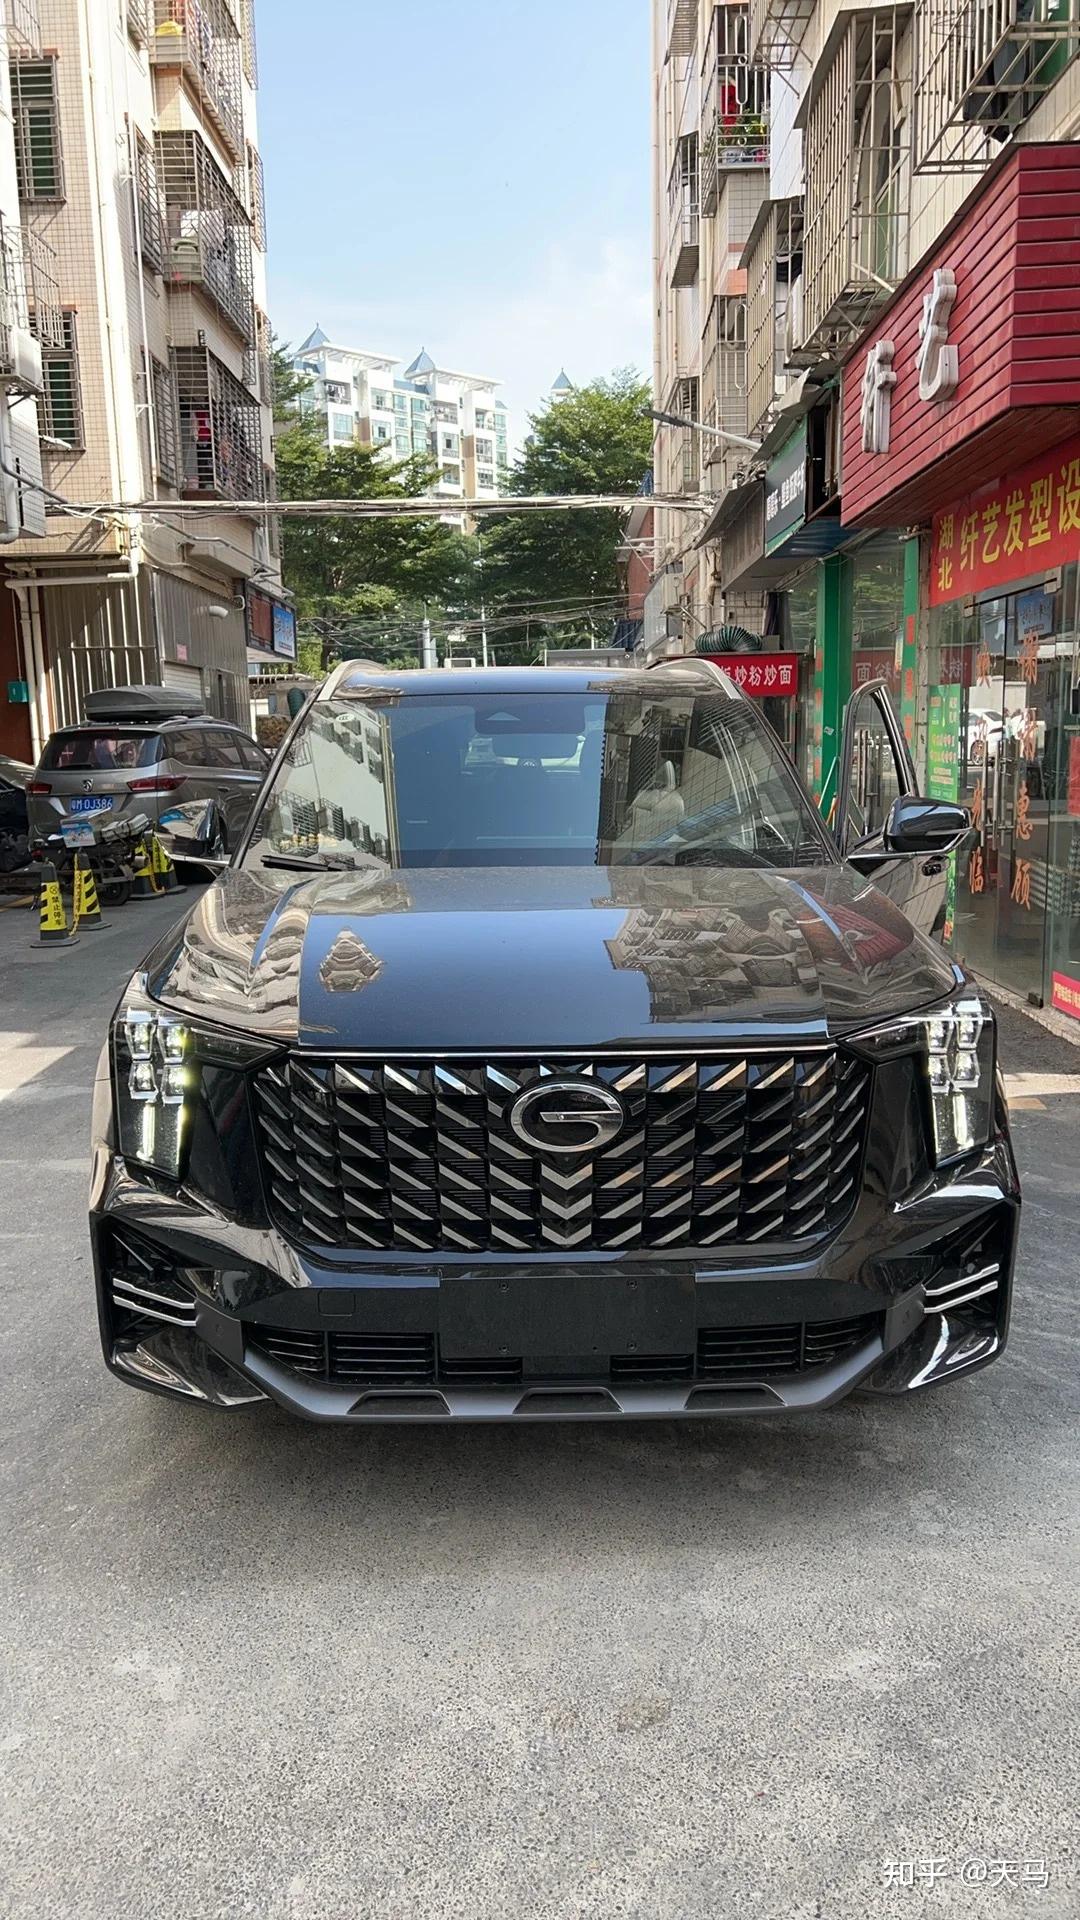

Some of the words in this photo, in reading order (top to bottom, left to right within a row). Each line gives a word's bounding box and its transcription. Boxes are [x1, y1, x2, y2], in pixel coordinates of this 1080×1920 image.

[938, 513, 954, 592] 湖北
[960, 458, 1080, 572] 纤艺发型设
